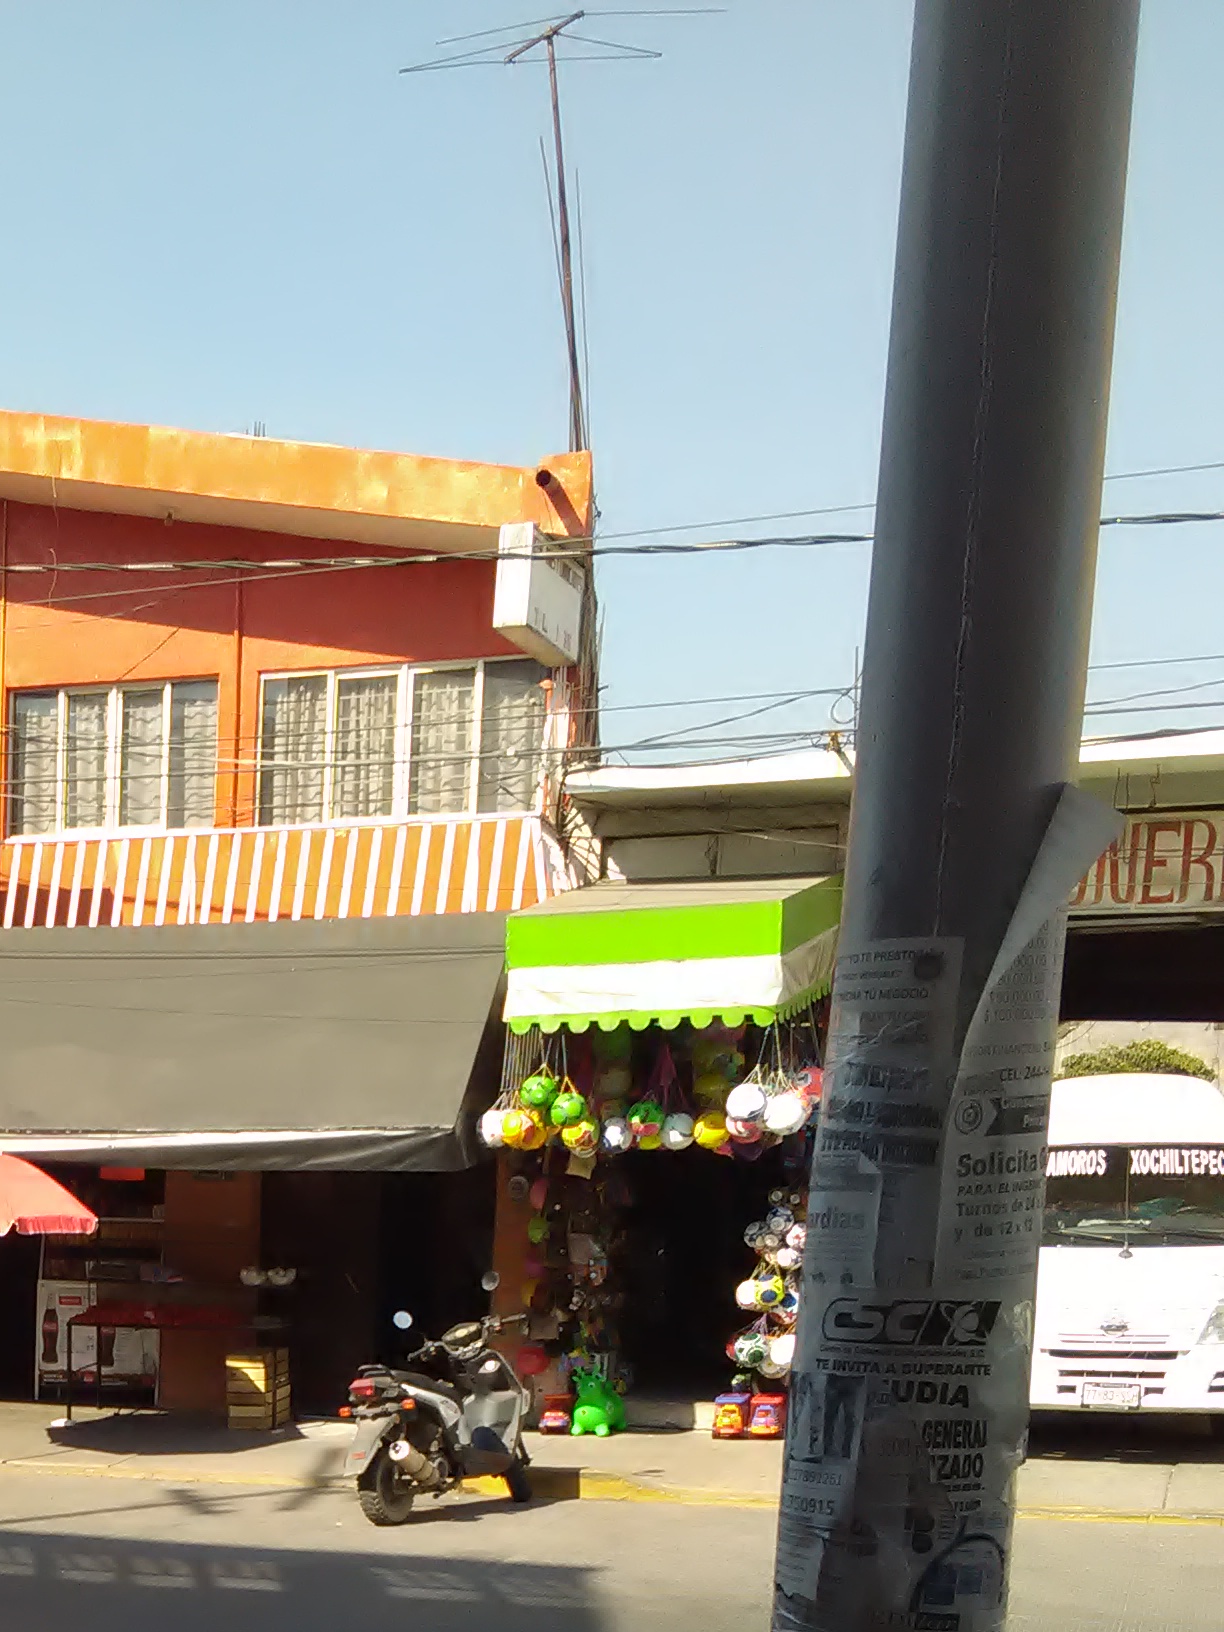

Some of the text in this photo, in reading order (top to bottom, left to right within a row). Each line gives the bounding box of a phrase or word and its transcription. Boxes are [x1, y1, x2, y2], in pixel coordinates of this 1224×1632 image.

[957, 1151, 1038, 1178] Solicita
[1046, 1150, 1107, 1176] AMOROS
[956, 1184, 993, 1197] PARA
[956, 1202, 1008, 1217] Turnos
[954, 1227, 963, 1244] y
[816, 1358, 993, 1376] TE INVITA A SUPERARTE
[884, 1378, 969, 1408] UDIA
[921, 1419, 989, 1448] GENERAL
